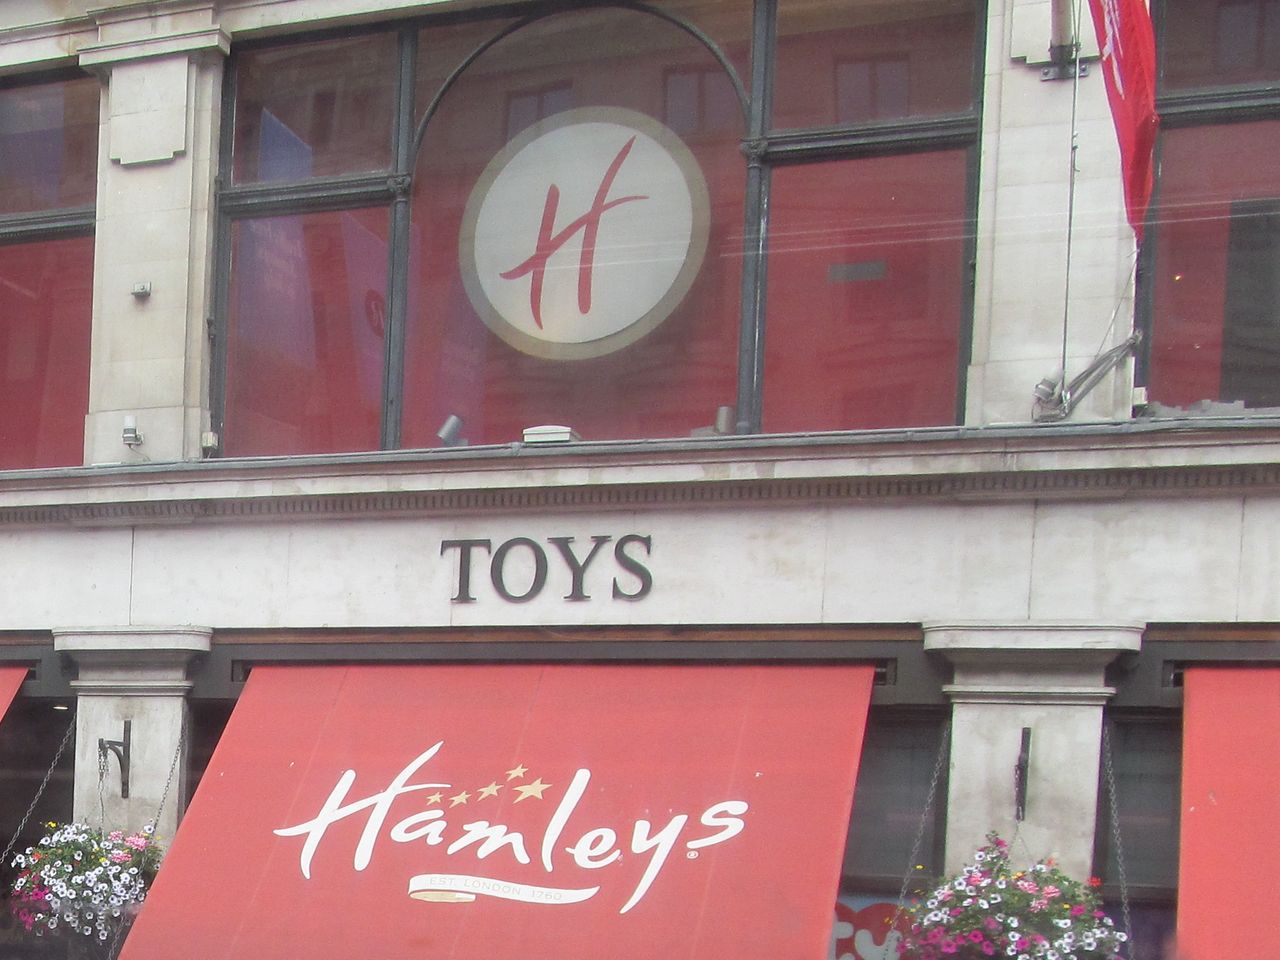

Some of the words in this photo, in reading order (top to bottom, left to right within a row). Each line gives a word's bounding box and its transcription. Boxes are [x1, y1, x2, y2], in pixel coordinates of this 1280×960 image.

[499, 135, 650, 330] H
[440, 533, 654, 604] TOYS
[272, 740, 749, 915] Hamleys
[463, 878, 522, 896] LONDON
[531, 889, 563, 901] 1760
